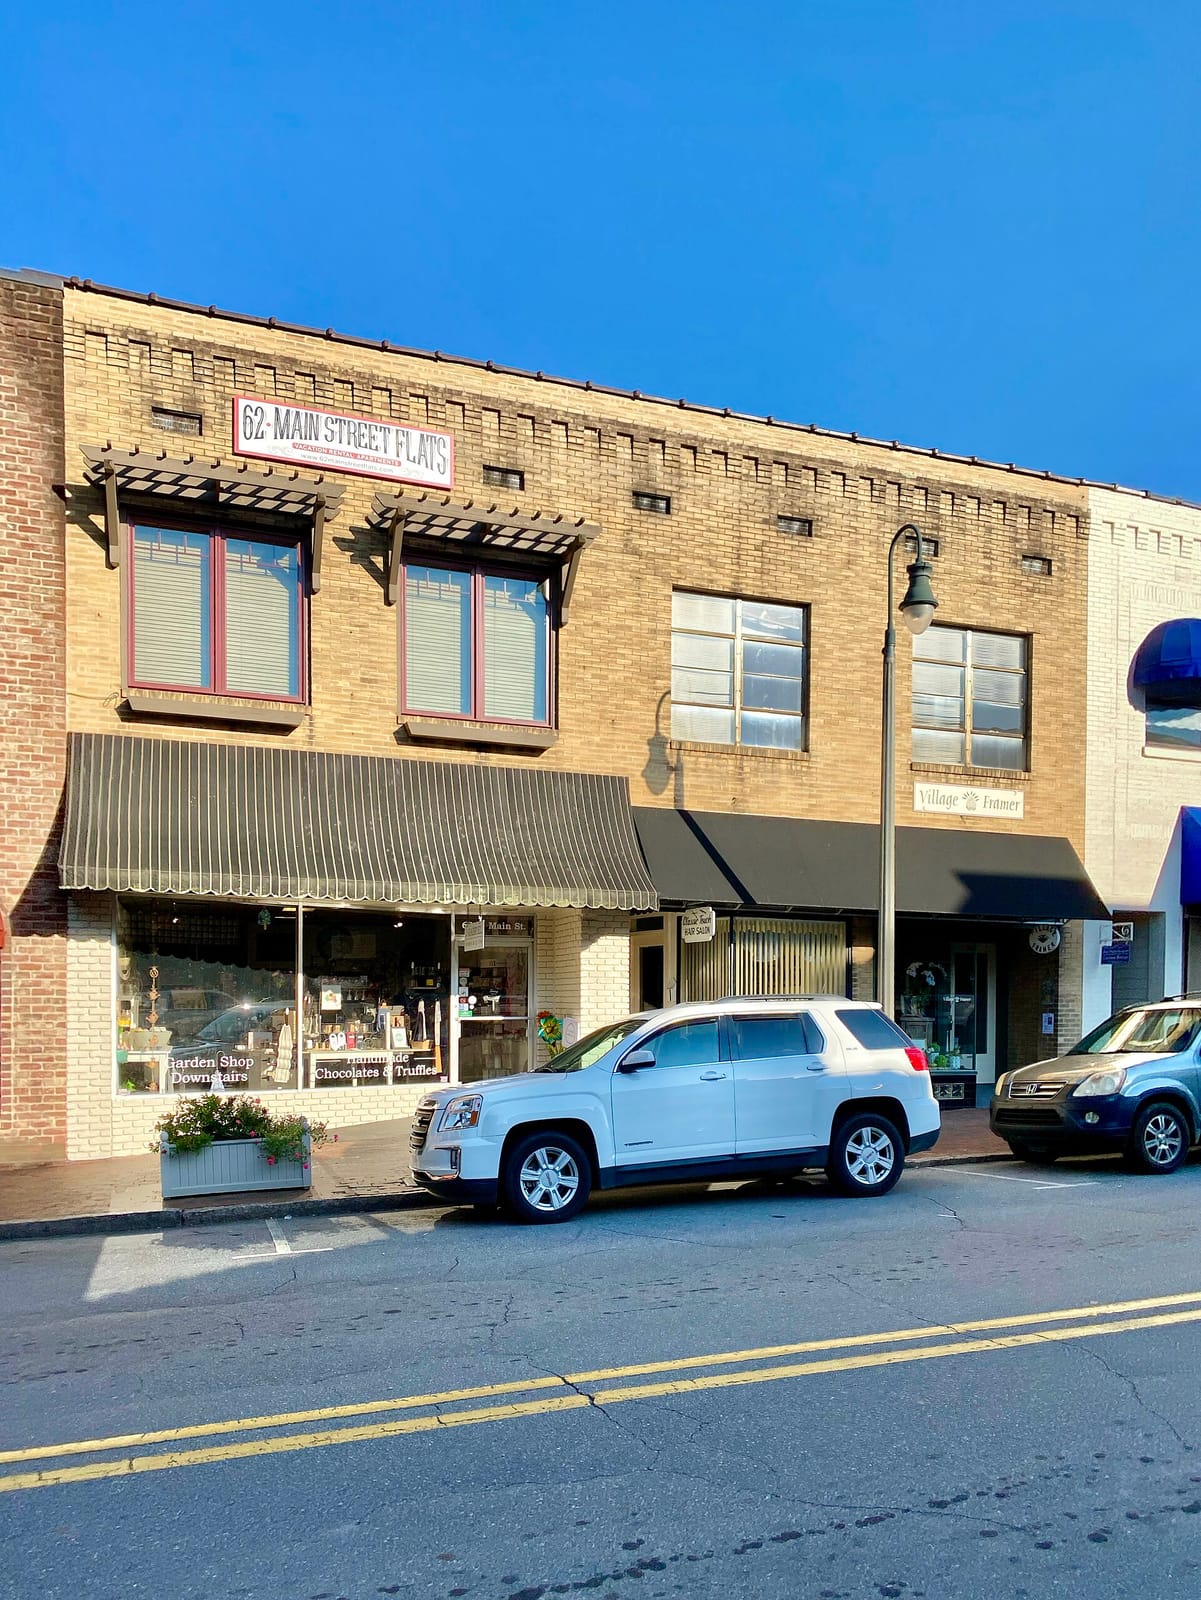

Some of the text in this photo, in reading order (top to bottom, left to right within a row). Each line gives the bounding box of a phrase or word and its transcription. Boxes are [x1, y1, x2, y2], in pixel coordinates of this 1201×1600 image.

[242, 404, 448, 476] 62 MAIN STREET FLATS
[294, 443, 400, 467] VACATION RENTAL APARTMENTS
[919, 788, 1021, 812] Village Framer
[487, 921, 526, 930] Main St.
[684, 926, 711, 936] HAIR SALON
[167, 1055, 255, 1070] Garden Shop
[171, 1070, 248, 1084] Downstairs
[315, 1067, 380, 1080] Chocolates
[395, 1064, 438, 1077] Truffles
